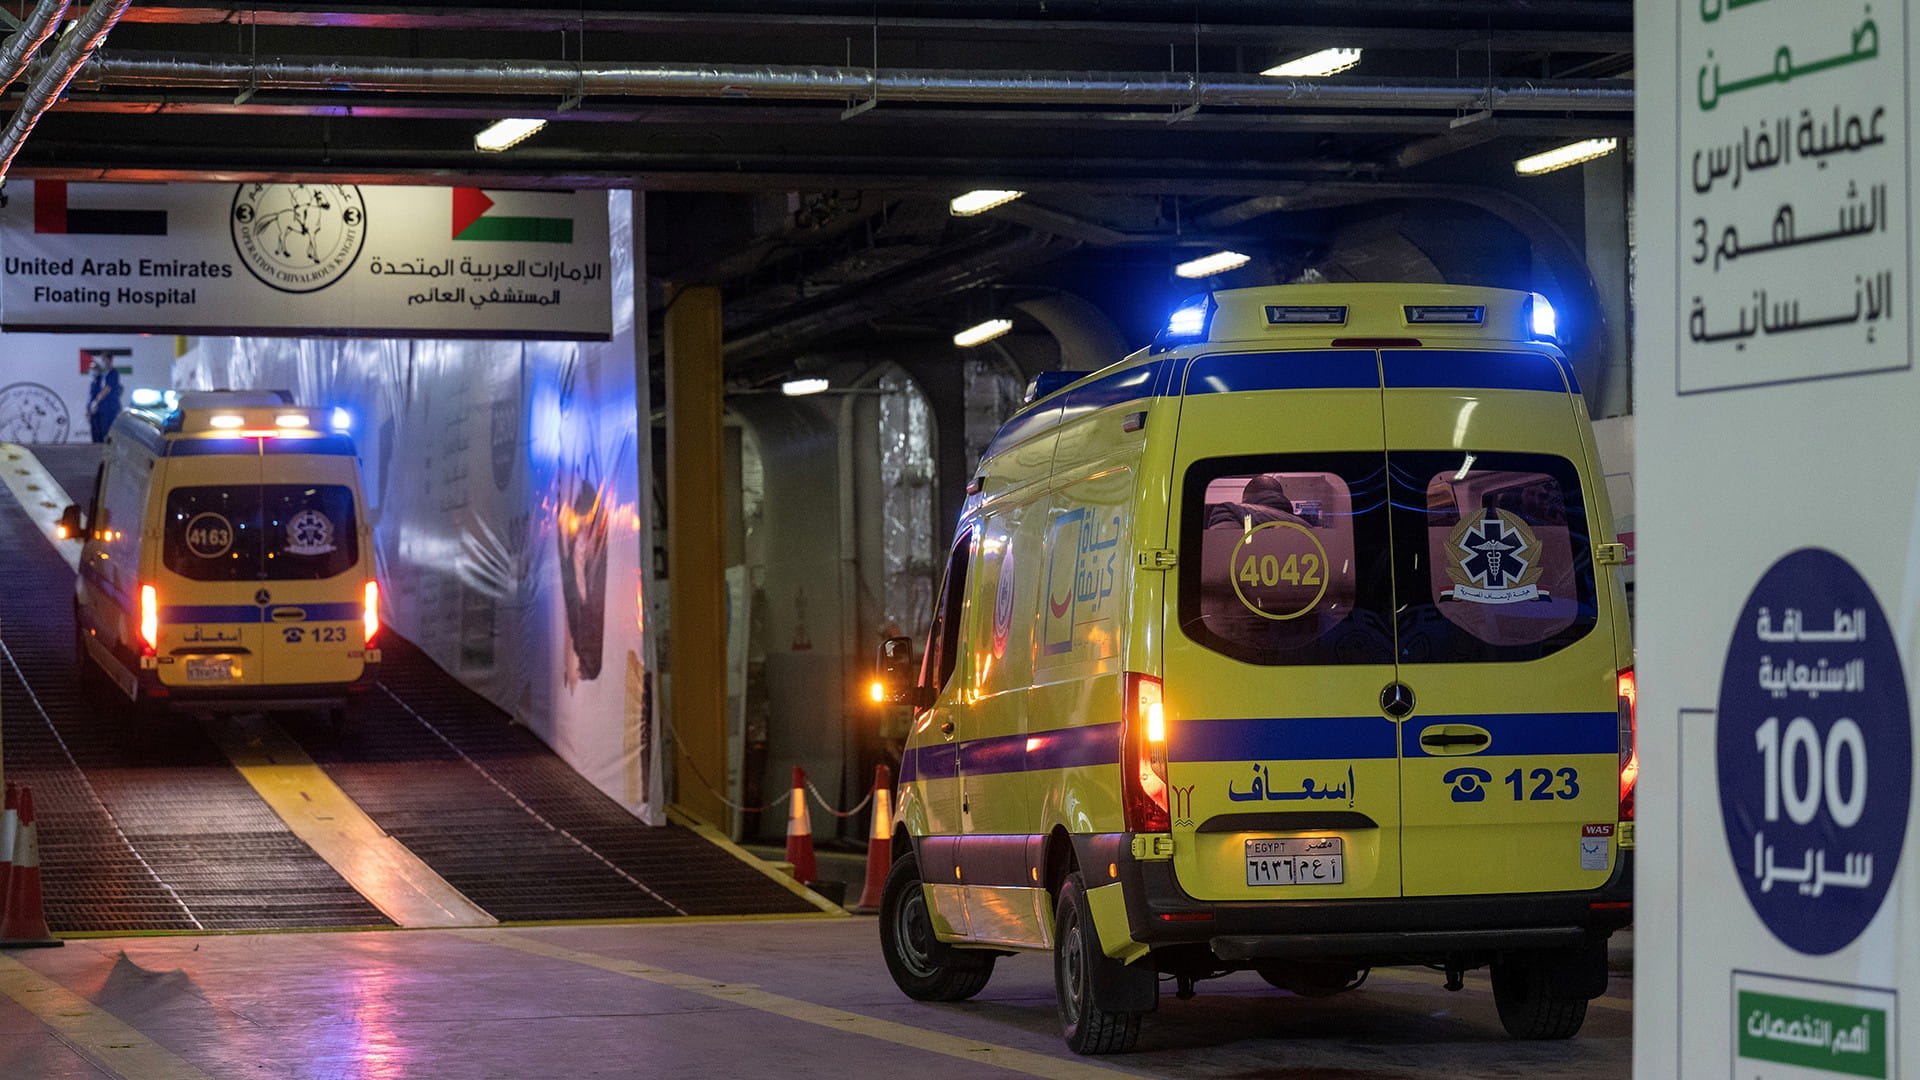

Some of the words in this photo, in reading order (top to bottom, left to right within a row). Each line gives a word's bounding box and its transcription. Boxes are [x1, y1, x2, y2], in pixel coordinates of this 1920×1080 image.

[1698, 3, 1880, 111] ضمن
[1692, 116, 1790, 194] الفارس
[1797, 105, 1885, 170] عملية
[1692, 217, 1708, 264] 3
[1713, 180, 1886, 272] الشهم
[5, 257, 73, 275] United
[81, 258, 131, 277] Arab
[139, 258, 232, 278] Emirates
[241, 226, 275, 277] OPERATION
[276, 261, 337, 283] CHIVALROUS
[335, 229, 357, 265] KNIGHT
[370, 256, 454, 278] المتحدة
[460, 257, 525, 282] العربية
[529, 261, 601, 284] الإمارات
[34, 286, 110, 307] Floating
[118, 287, 196, 308] Hospital
[1689, 270, 1892, 351] الإنسانية
[190, 529, 228, 545] 4163
[1082, 507, 1120, 564] حياة
[1077, 552, 1116, 612] كريمة
[1240, 554, 1320, 586] 4042
[312, 627, 347, 642] 123
[1757, 606, 1866, 642] الطاقة
[1759, 655, 1864, 698] الاستيعابية
[1229, 763, 1354, 808] إسعاف
[1505, 767, 1580, 800] 123
[1754, 716, 1868, 828] 100
[1255, 843, 1285, 853] EGYPT
[1306, 840, 1333, 852] مصر
[1586, 825, 1610, 834] WAS
[1249, 860, 1293, 881] ٦٩٣٦
[1754, 831, 1873, 898] سريرا
[1832, 1013, 1870, 1056] أهم
